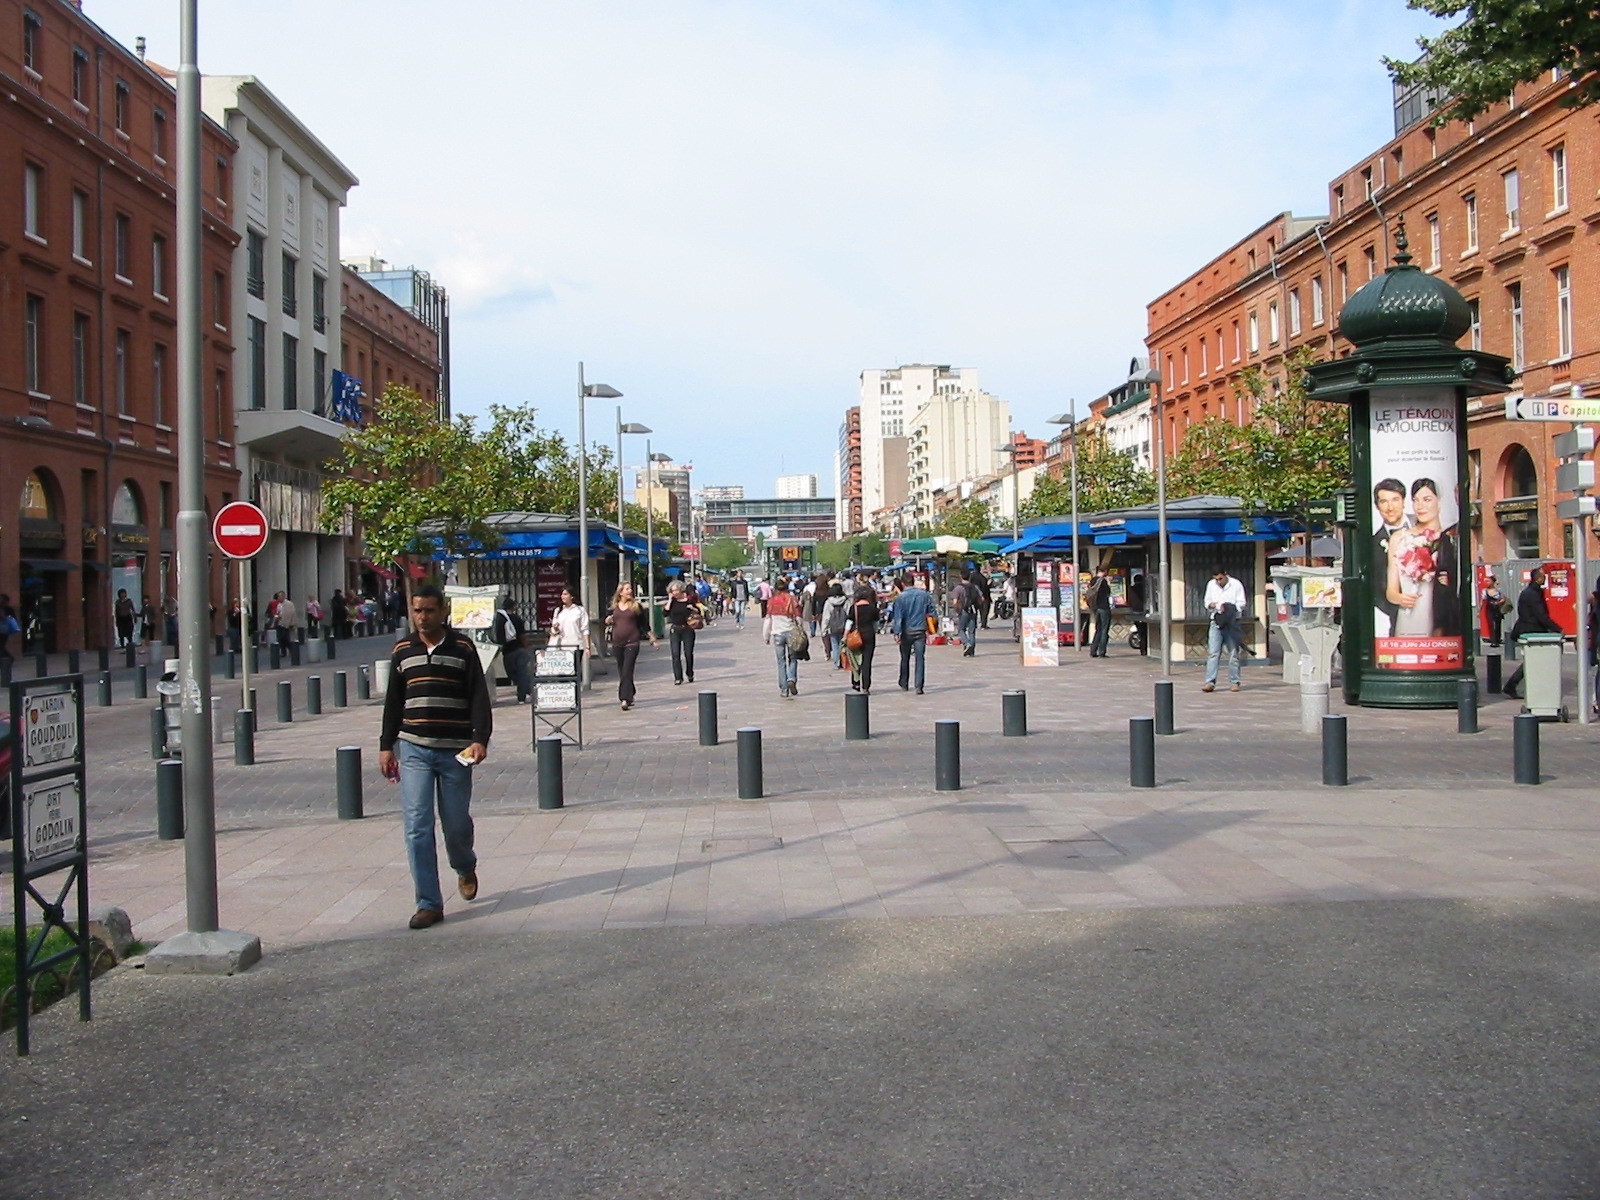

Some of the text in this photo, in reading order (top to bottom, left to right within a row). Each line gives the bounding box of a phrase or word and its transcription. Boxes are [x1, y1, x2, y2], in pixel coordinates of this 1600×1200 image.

[1375, 406, 1454, 421] LE TÉMOIN
[1376, 420, 1455, 433] AMOUREUX
[40, 697, 65, 713] JARDIN
[36, 819, 74, 843] GODOLIN
